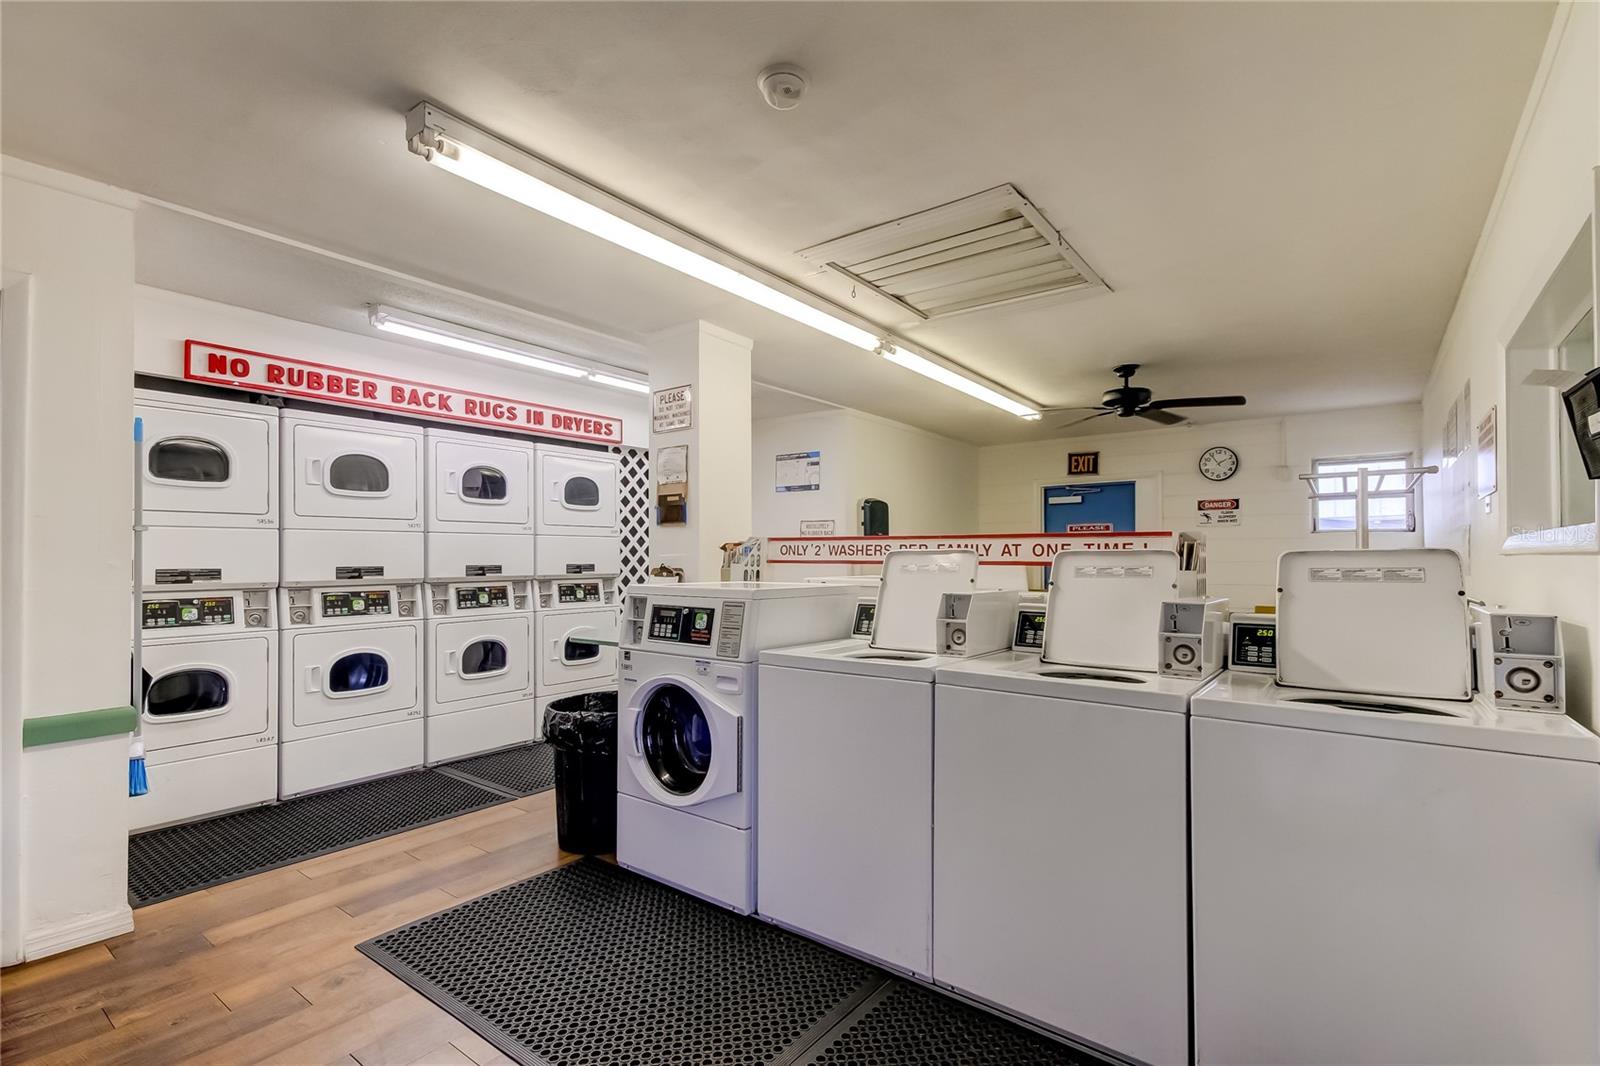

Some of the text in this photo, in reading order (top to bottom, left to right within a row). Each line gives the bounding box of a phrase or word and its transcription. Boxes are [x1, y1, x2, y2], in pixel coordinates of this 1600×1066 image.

[208, 353, 613, 436] NO RUBBER BACK RUGS IN DRYERS
[660, 390, 685, 404] PLEASE
[1071, 455, 1095, 473] EXIT
[780, 544, 809, 556] ONLY
[828, 544, 893, 556] WASHERS
[1000, 544, 1022, 557] AT
[1257, 629, 1274, 637] 250
